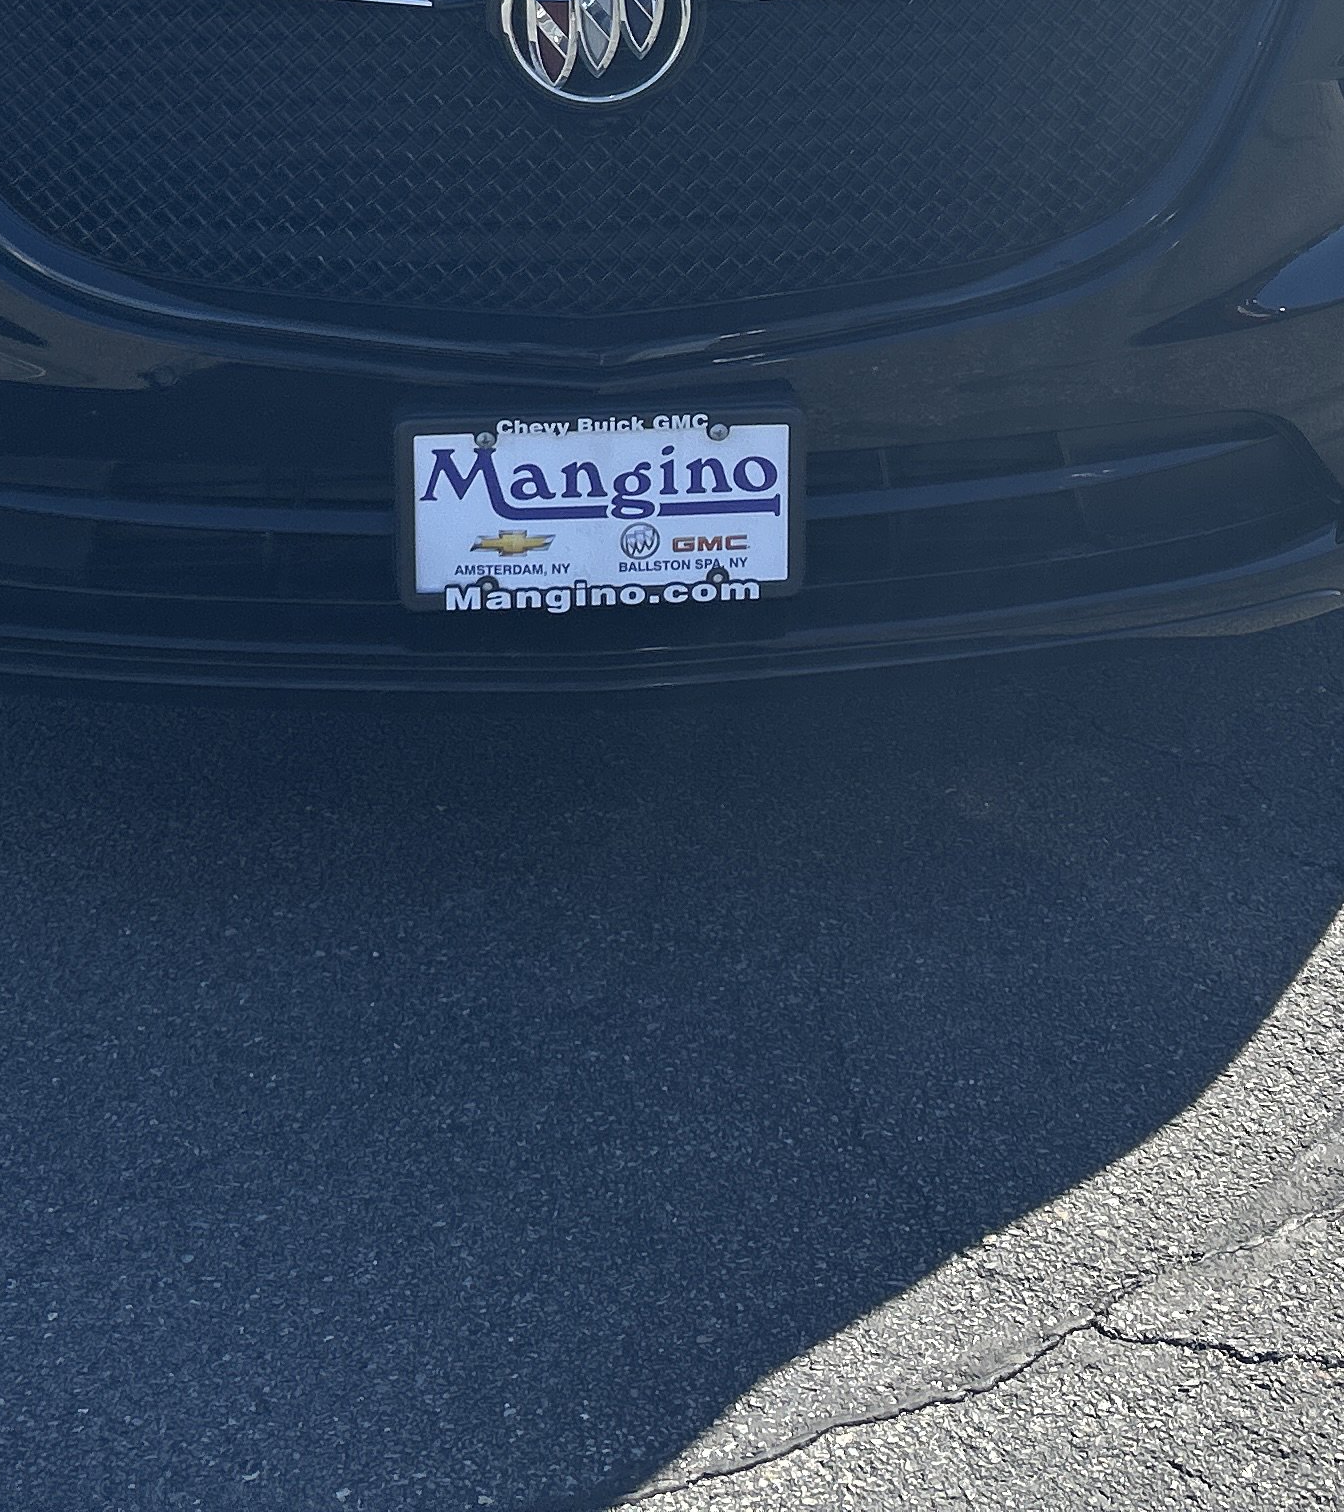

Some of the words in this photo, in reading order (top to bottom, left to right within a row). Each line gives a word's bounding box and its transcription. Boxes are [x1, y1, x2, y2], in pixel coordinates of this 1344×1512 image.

[496, 419, 570, 437] Chevy
[577, 415, 645, 432] Buick
[653, 413, 708, 430] GMC
[420, 445, 781, 521] Mangino
[672, 534, 749, 553] GMC
[454, 563, 548, 577] AMSTERDAM,
[552, 562, 571, 575] NY
[619, 559, 691, 573] BALLSTON
[729, 556, 748, 569] NY
[445, 578, 761, 614] Mangino.com
